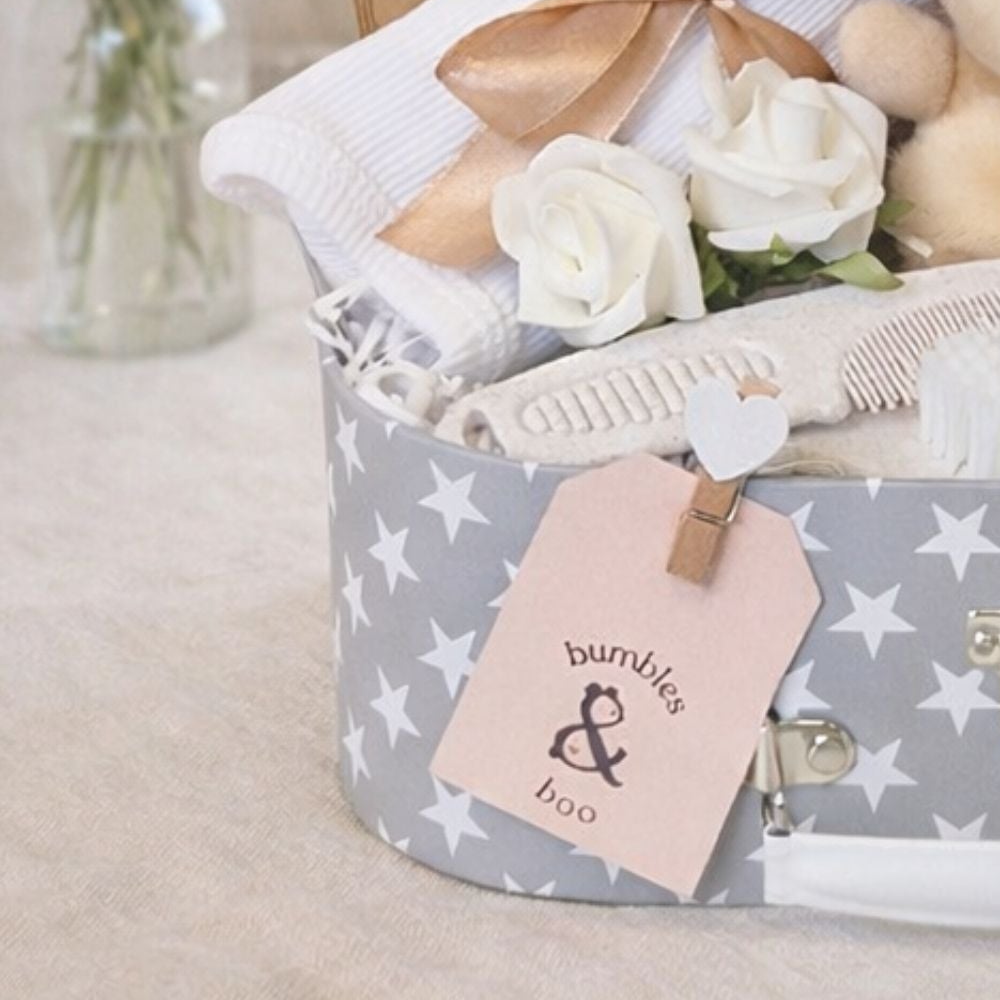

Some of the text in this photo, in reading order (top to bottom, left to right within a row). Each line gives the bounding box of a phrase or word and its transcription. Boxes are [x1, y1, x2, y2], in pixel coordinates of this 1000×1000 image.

[564, 640, 686, 717] bumbles
[548, 681, 628, 789] &
[533, 776, 598, 825] boo
